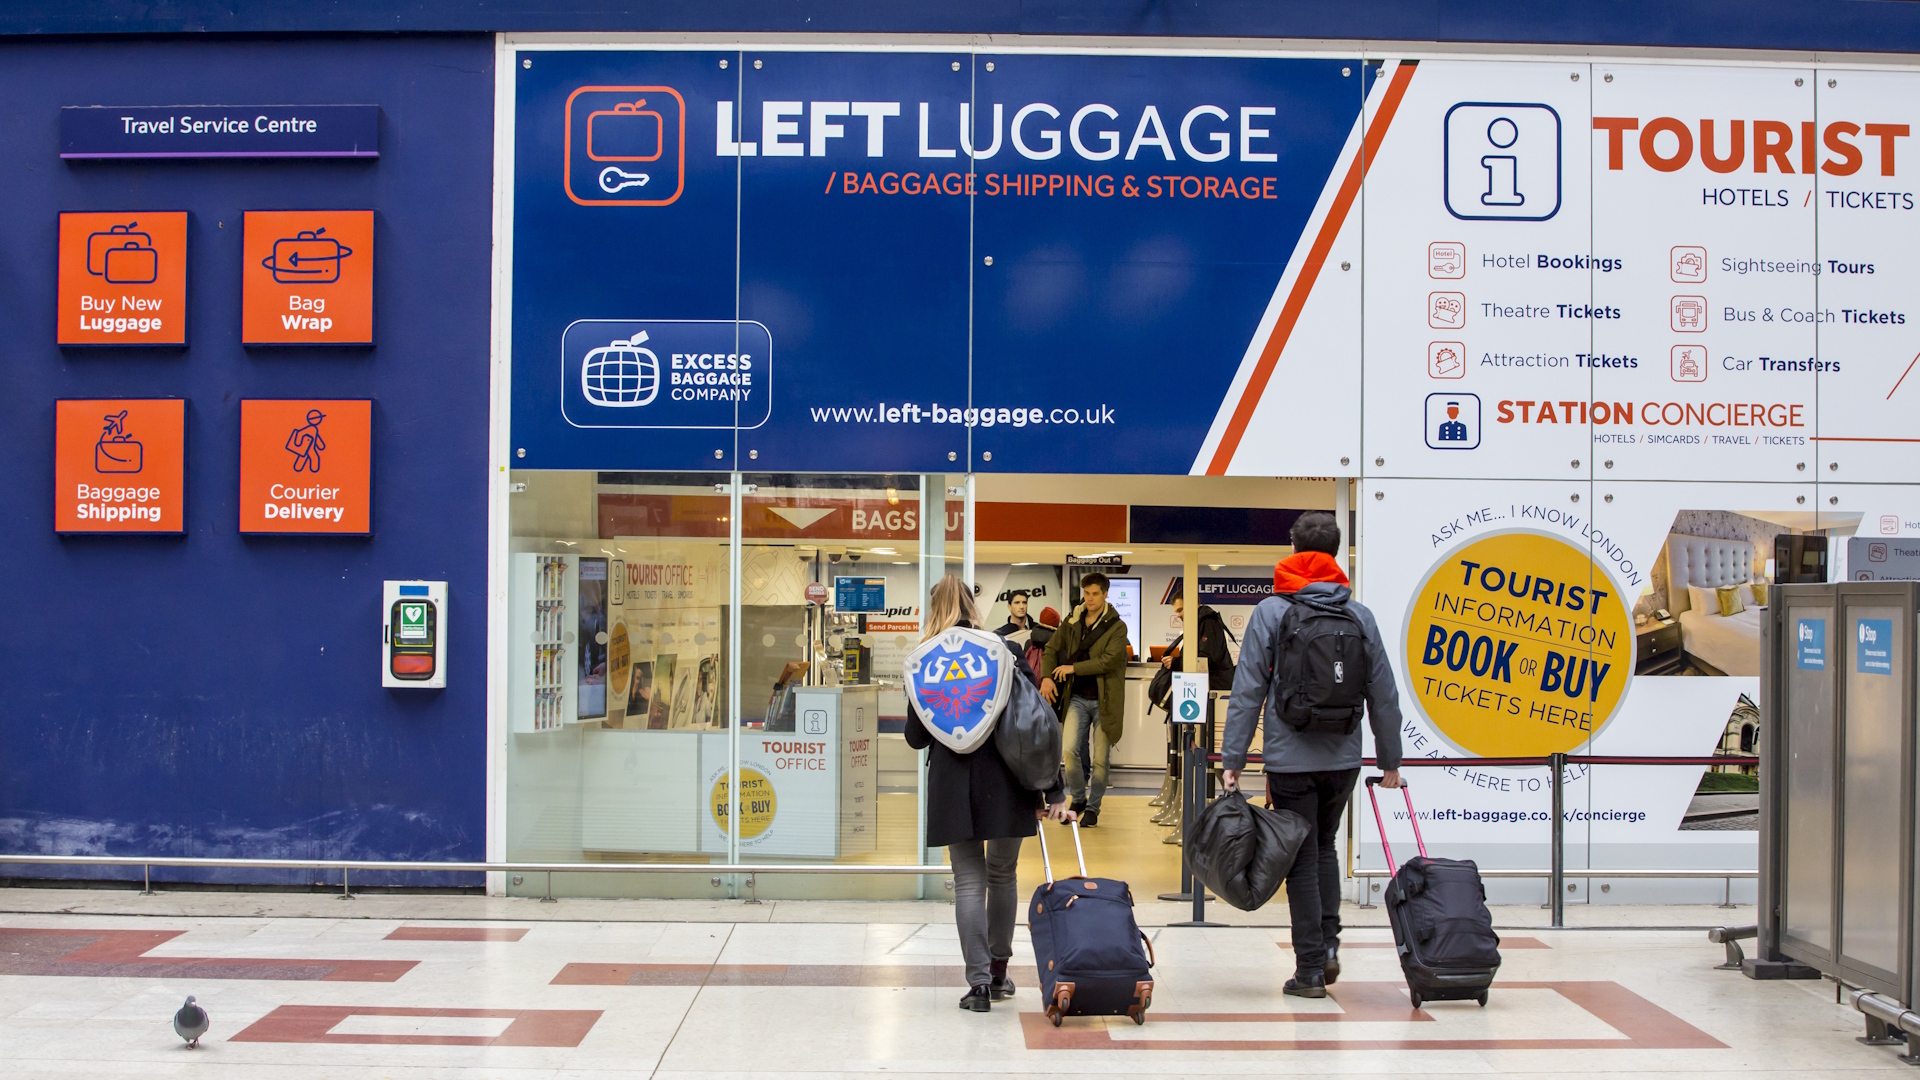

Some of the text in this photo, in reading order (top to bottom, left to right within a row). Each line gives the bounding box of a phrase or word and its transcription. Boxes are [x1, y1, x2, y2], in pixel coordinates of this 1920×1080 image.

[121, 116, 317, 134] Travel Service Centre
[717, 101, 1278, 162] LEFT LUGGAGE
[1592, 116, 1910, 176] TOURIST
[844, 172, 977, 196] BAGGAGE
[985, 174, 1115, 197] SHIPPING
[1121, 175, 1139, 198] &
[1147, 176, 1278, 199] STORAGE
[1702, 188, 1790, 208] HOTELS
[1826, 190, 1914, 210] TICKETS
[1482, 253, 1622, 272] Hotel Bookings
[1721, 258, 1875, 275] Sightseeing Tours
[80, 296, 162, 314] Buy New
[289, 296, 325, 314] Bag
[1481, 303, 1621, 319] Theatre Tickets
[80, 316, 162, 332] Luggage
[281, 316, 333, 332] Wrap
[1724, 307, 1906, 324] Bus & Coach Tickets
[671, 353, 752, 370] EXCESS
[1480, 352, 1638, 368] Attraction Tickets
[1722, 356, 1841, 372] Car Transfers
[671, 372, 752, 386] BAGGAGE
[670, 387, 752, 401] COMPANY
[811, 402, 1115, 427] www.left-baggage.co.uk
[1496, 400, 1804, 427] STATION CONCIERGE
[1594, 434, 1636, 444] HOTELS
[1648, 434, 1700, 444] SIMCARDS
[1712, 435, 1751, 445] TRAVEL
[1763, 436, 1805, 446] TICKETS
[77, 484, 160, 503] Baggage
[270, 484, 340, 500] Courier
[77, 504, 161, 522] Shipping
[264, 504, 344, 522] Delivery
[852, 510, 916, 531] BAGS
[1431, 505, 1642, 586] ASK ME... I KNOW LONDON
[1068, 556, 1097, 564] Baggage
[626, 564, 693, 586] TOURIST OFFICE
[1198, 584, 1225, 593] LEFT
[1460, 560, 1608, 614] TOURIST
[1434, 592, 1616, 650] INFORMATION
[1866, 626, 1876, 644] Stop
[1422, 624, 1611, 702] BOOK OR BUY
[1184, 688, 1196, 698] IN
[1424, 676, 1594, 732] TICKETS HERE
[762, 741, 826, 755] TOURIST
[849, 739, 870, 752] TOURIST
[776, 758, 826, 771] OFFICE
[1403, 720, 1428, 750] WE
[1464, 769, 1511, 792] HERE
[1518, 778, 1540, 792] TO
[720, 780, 764, 790] TRIST
[716, 790, 770, 800] INFMATION
[717, 802, 744, 816] BOK
[752, 800, 770, 814] BUY
[1394, 808, 1646, 823] www.left-baggage.co.k/concierge
